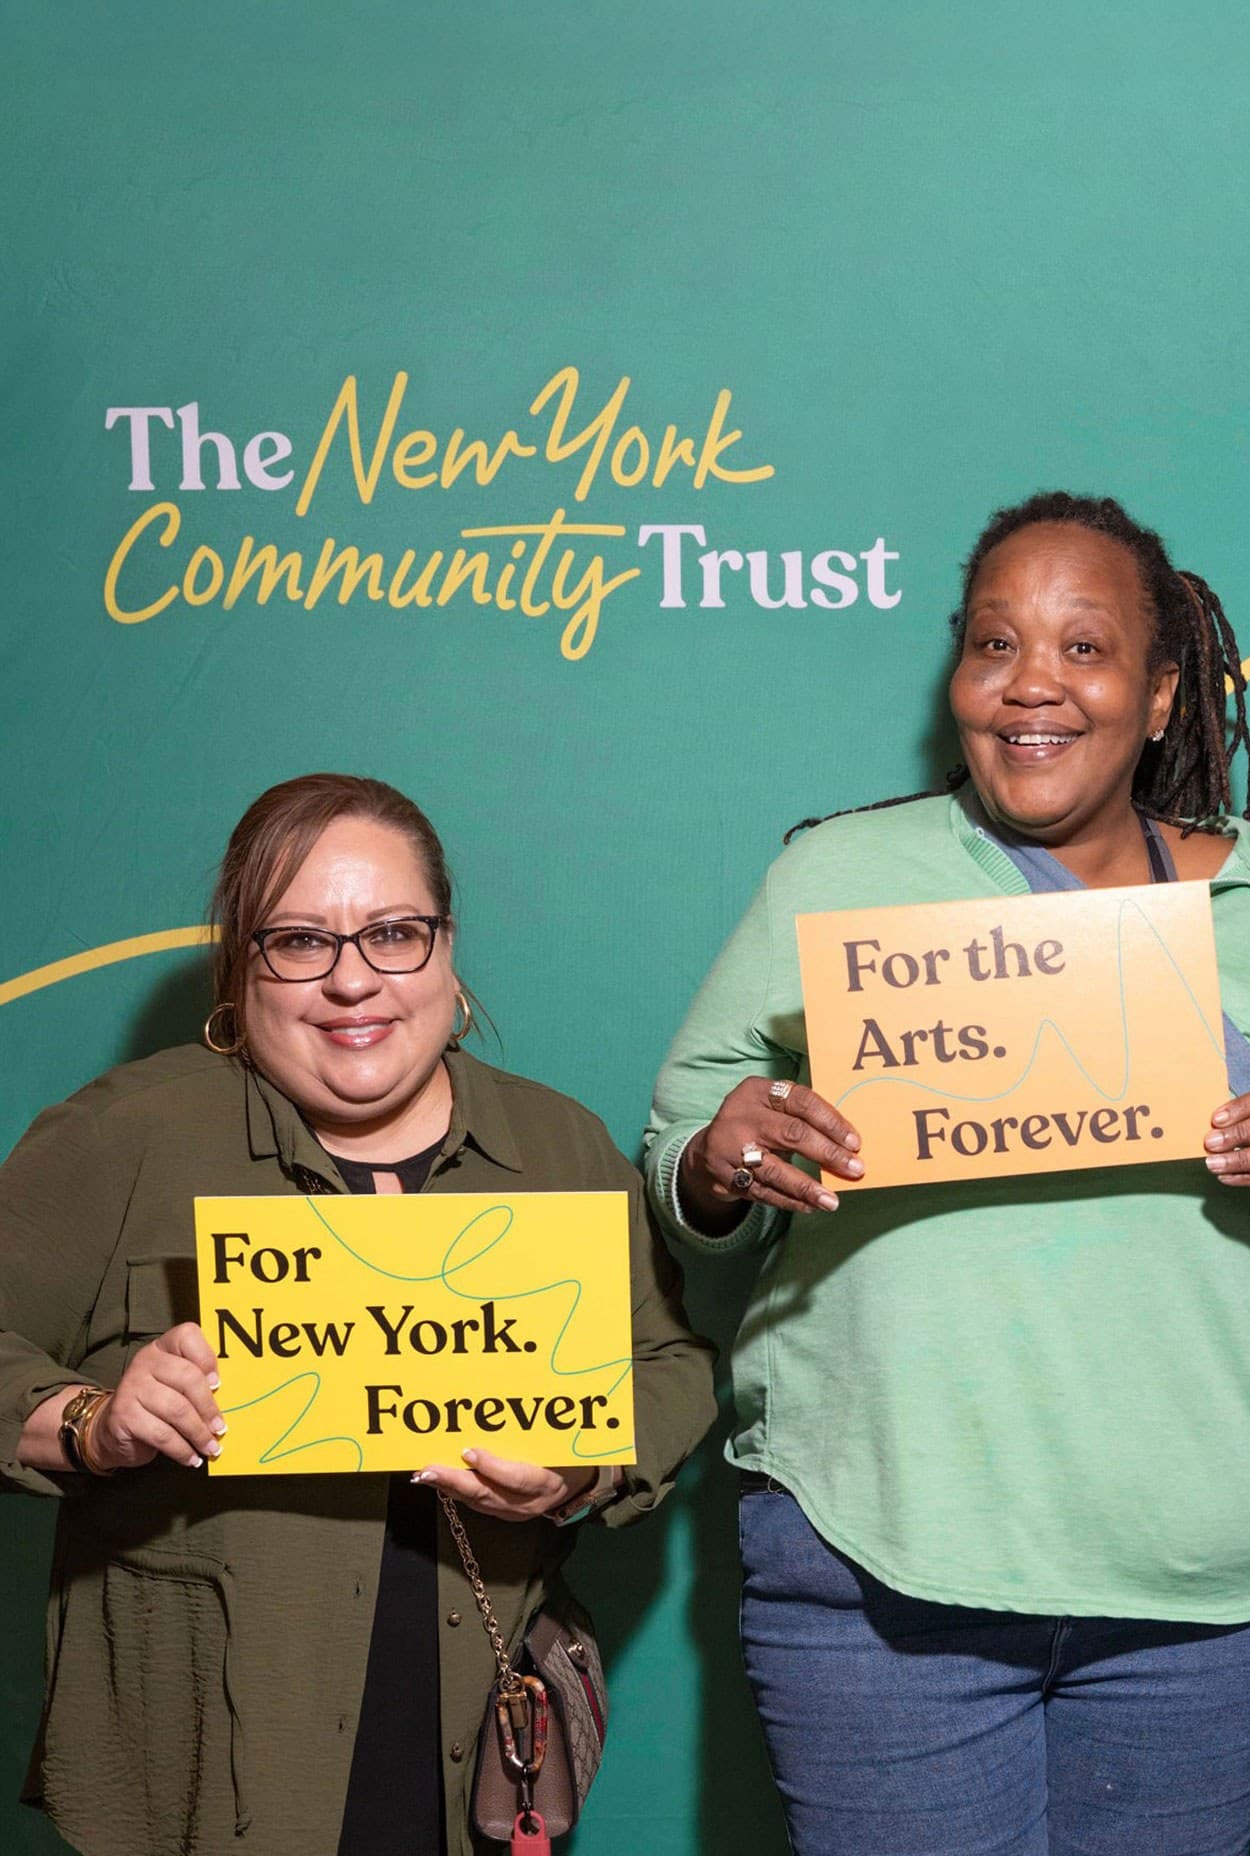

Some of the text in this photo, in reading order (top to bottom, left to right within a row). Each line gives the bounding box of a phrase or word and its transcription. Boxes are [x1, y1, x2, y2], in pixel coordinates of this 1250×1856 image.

[104, 366, 776, 517] The New York
[104, 501, 903, 661] Community Trust
[842, 925, 1067, 993] For the
[851, 1017, 1008, 1071] Arts.
[911, 1104, 1165, 1160] Forever.
[210, 1232, 323, 1284] For
[214, 1300, 538, 1360] New York.
[364, 1384, 621, 1435] Forever.
